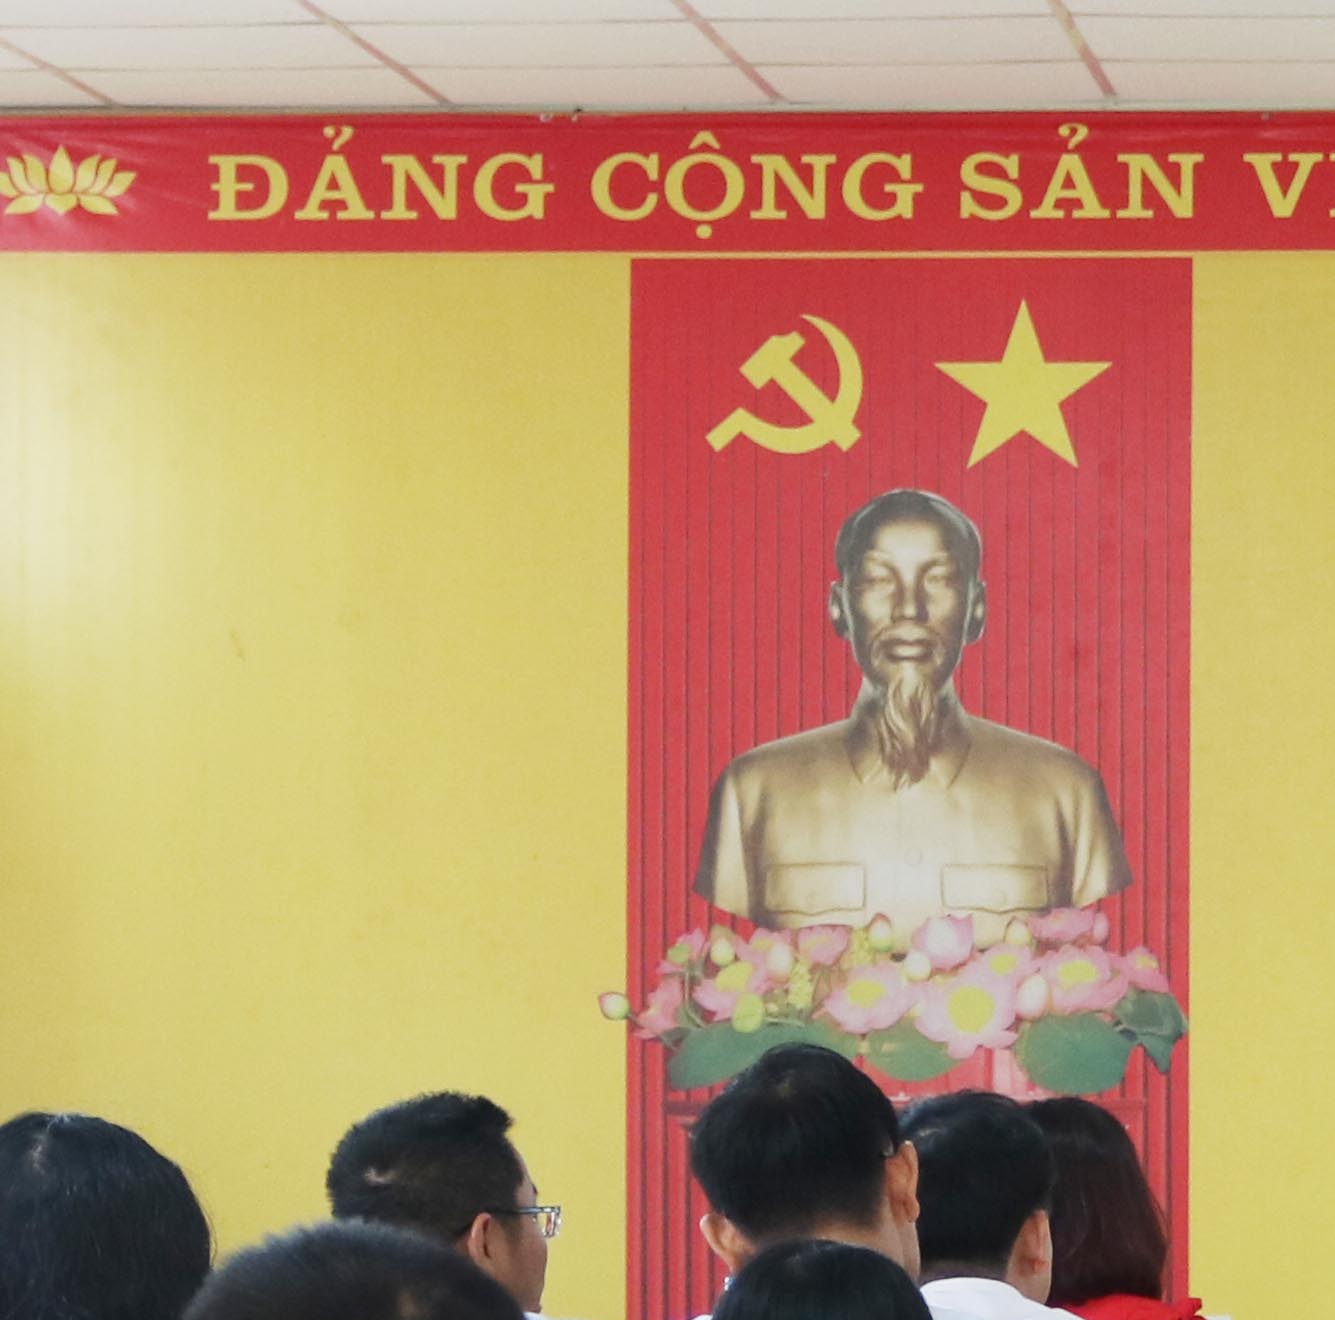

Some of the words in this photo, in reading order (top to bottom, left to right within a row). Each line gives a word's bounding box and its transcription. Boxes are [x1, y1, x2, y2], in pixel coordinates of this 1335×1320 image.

[207, 126, 554, 221] ĐẢNG
[591, 131, 923, 239] CỘNG
[960, 125, 1204, 220] SẢN
